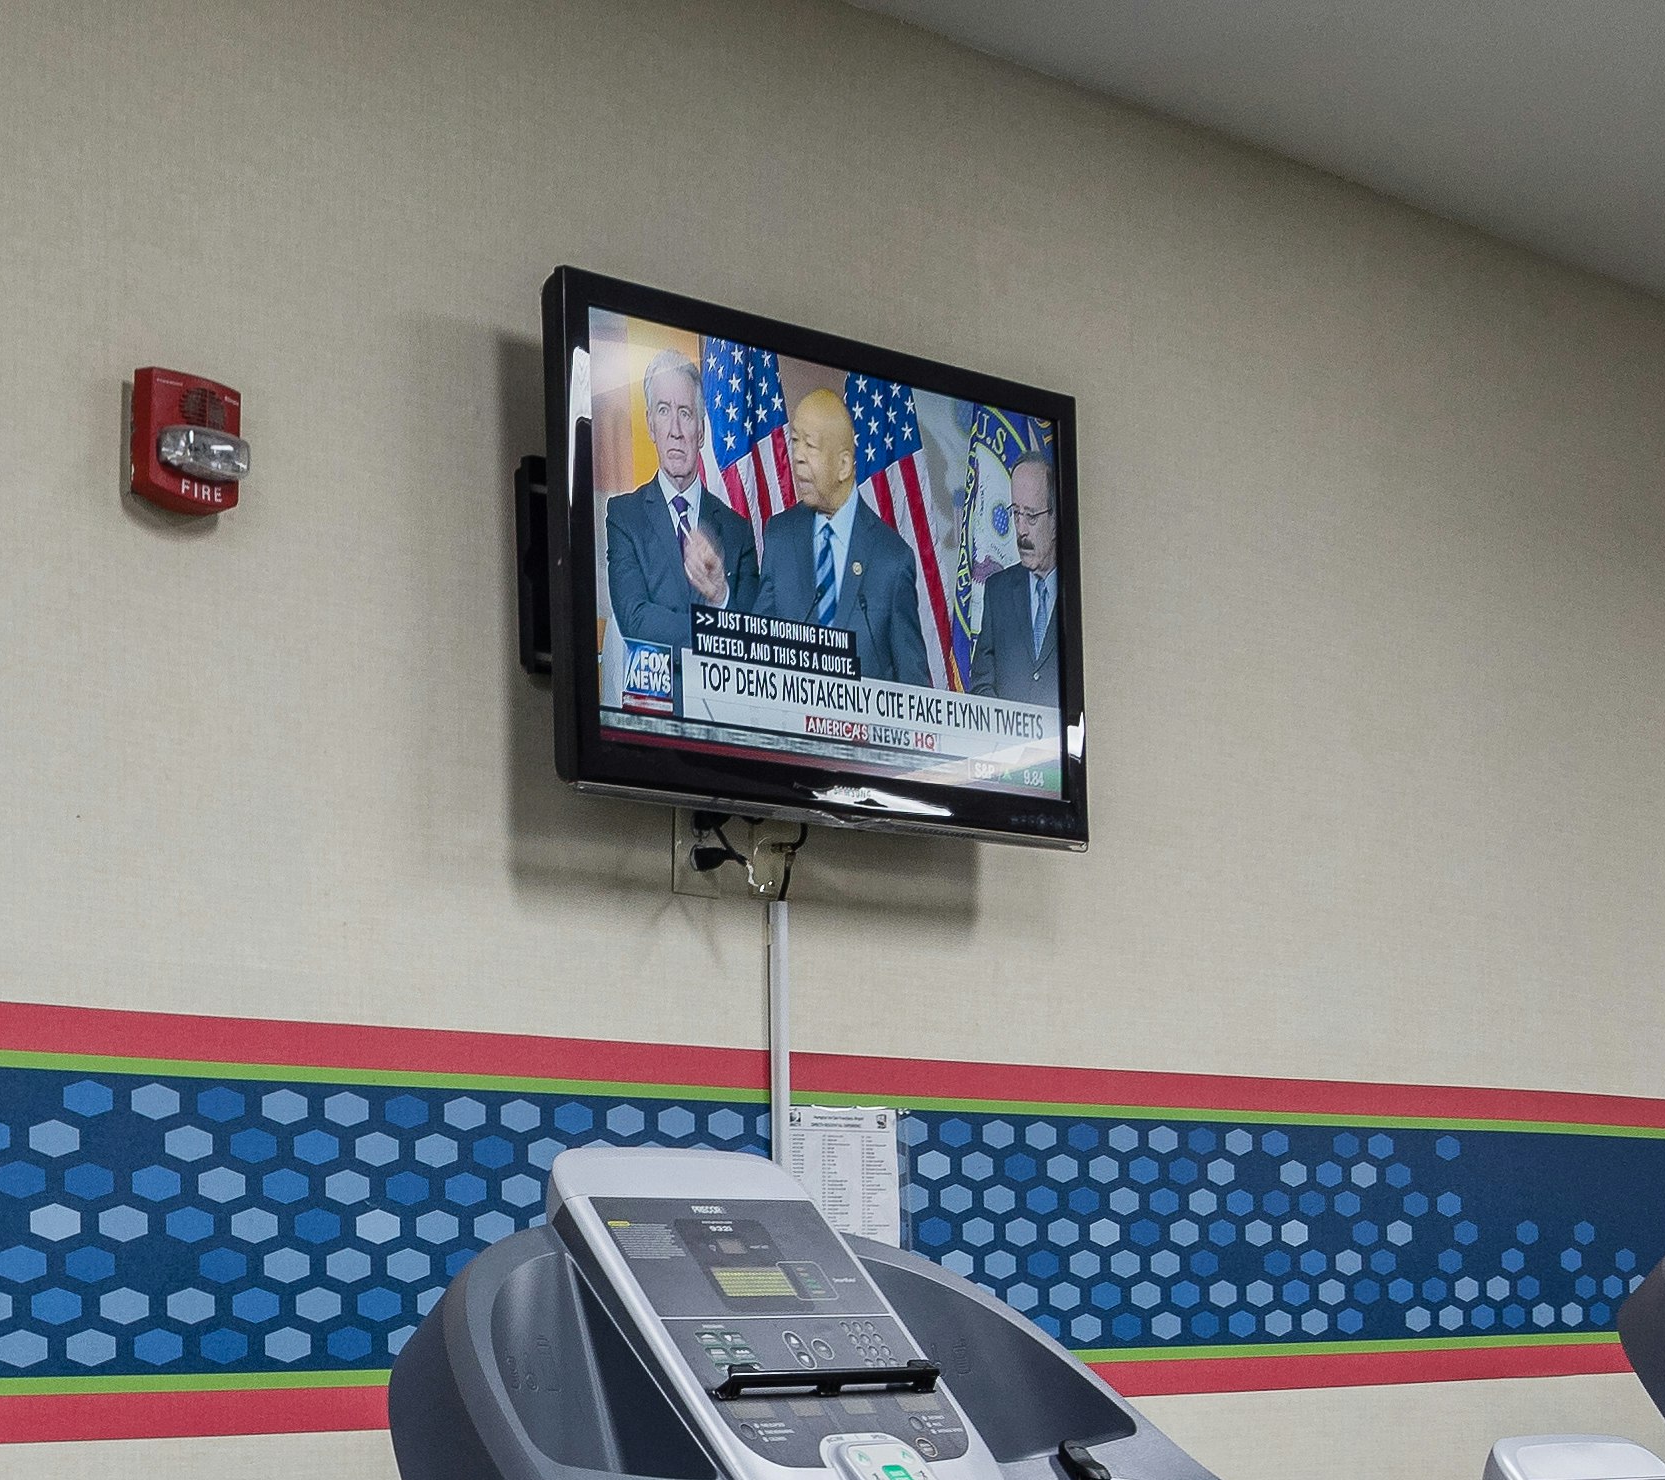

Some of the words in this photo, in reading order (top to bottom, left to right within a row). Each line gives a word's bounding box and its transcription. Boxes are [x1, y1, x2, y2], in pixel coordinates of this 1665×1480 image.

[181, 478, 223, 502] FIRE
[717, 611, 740, 632] JUST
[743, 615, 767, 636] THIS
[770, 620, 816, 644] MORNING
[819, 628, 849, 650] FLYNN
[640, 650, 670, 673] FOX
[696, 633, 748, 661] TWEETED,
[750, 642, 770, 662] AND
[773, 646, 796, 666] THIS
[799, 651, 809, 668] IS
[812, 654, 819, 670] A
[821, 655, 856, 676] QUOTE.
[629, 667, 671, 693] NEWS
[701, 661, 731, 692] TOP
[736, 668, 777, 701] DEMS
[783, 674, 872, 715] MISTAKENLY
[876, 689, 904, 720] CITE
[909, 695, 942, 726] FAKE
[947, 701, 991, 733] FLYNN
[994, 708, 1044, 741] TWEETS
[872, 726, 911, 747] NEWS
[914, 732, 936, 751] HQ
[974, 762, 995, 780] S&P
[1023, 769, 1045, 787] 9.84
